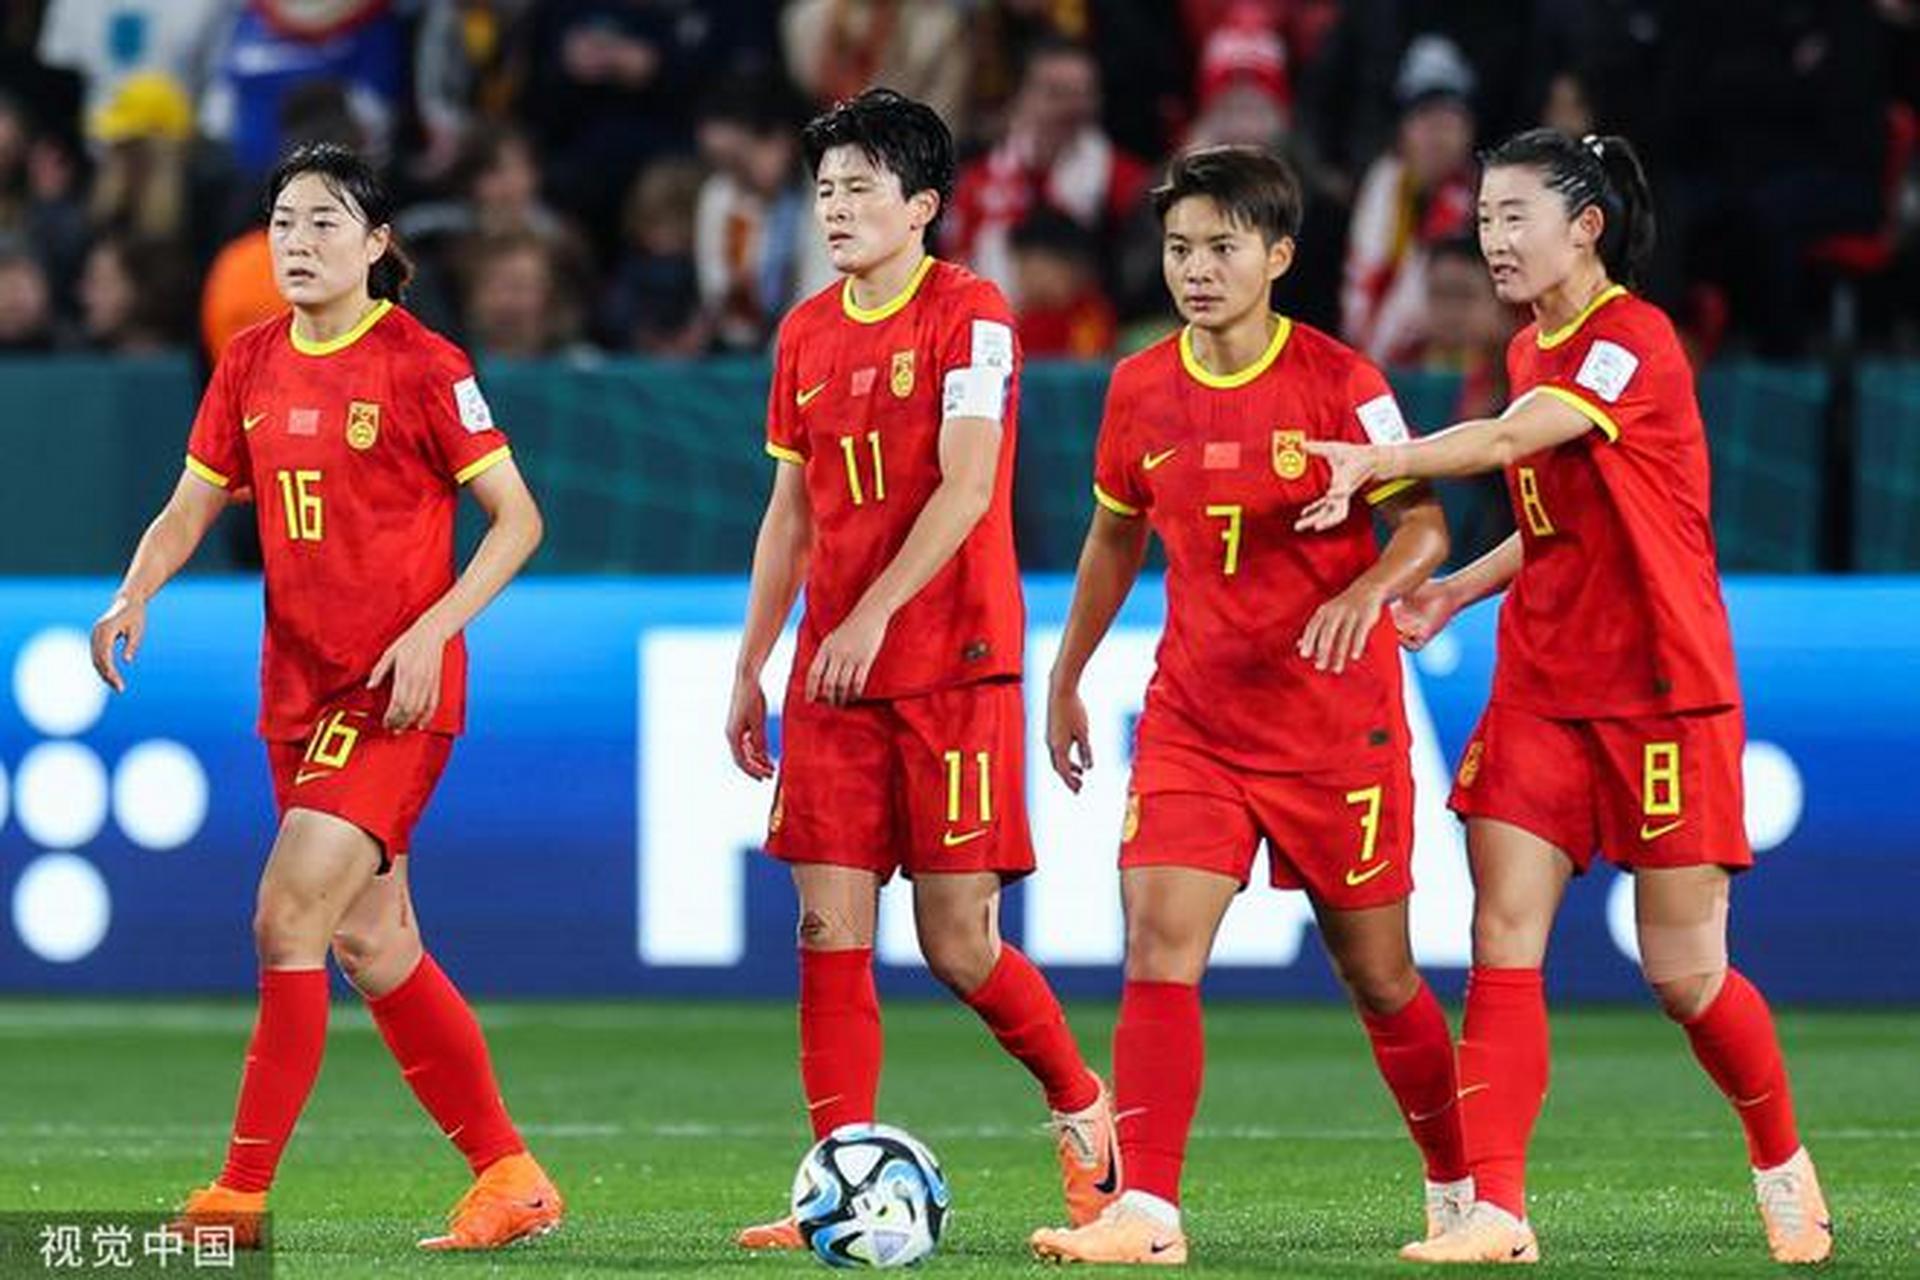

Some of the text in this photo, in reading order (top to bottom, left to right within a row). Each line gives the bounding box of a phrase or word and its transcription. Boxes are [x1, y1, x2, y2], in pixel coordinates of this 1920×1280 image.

[840, 430, 885, 505] 11
[1517, 466, 1555, 536] 8
[277, 470, 324, 541] 16
[1205, 504, 1243, 576] 7
[303, 708, 369, 769] 16
[943, 749, 992, 823] 11
[1642, 741, 1681, 816] 8
[1345, 784, 1383, 862] 7
